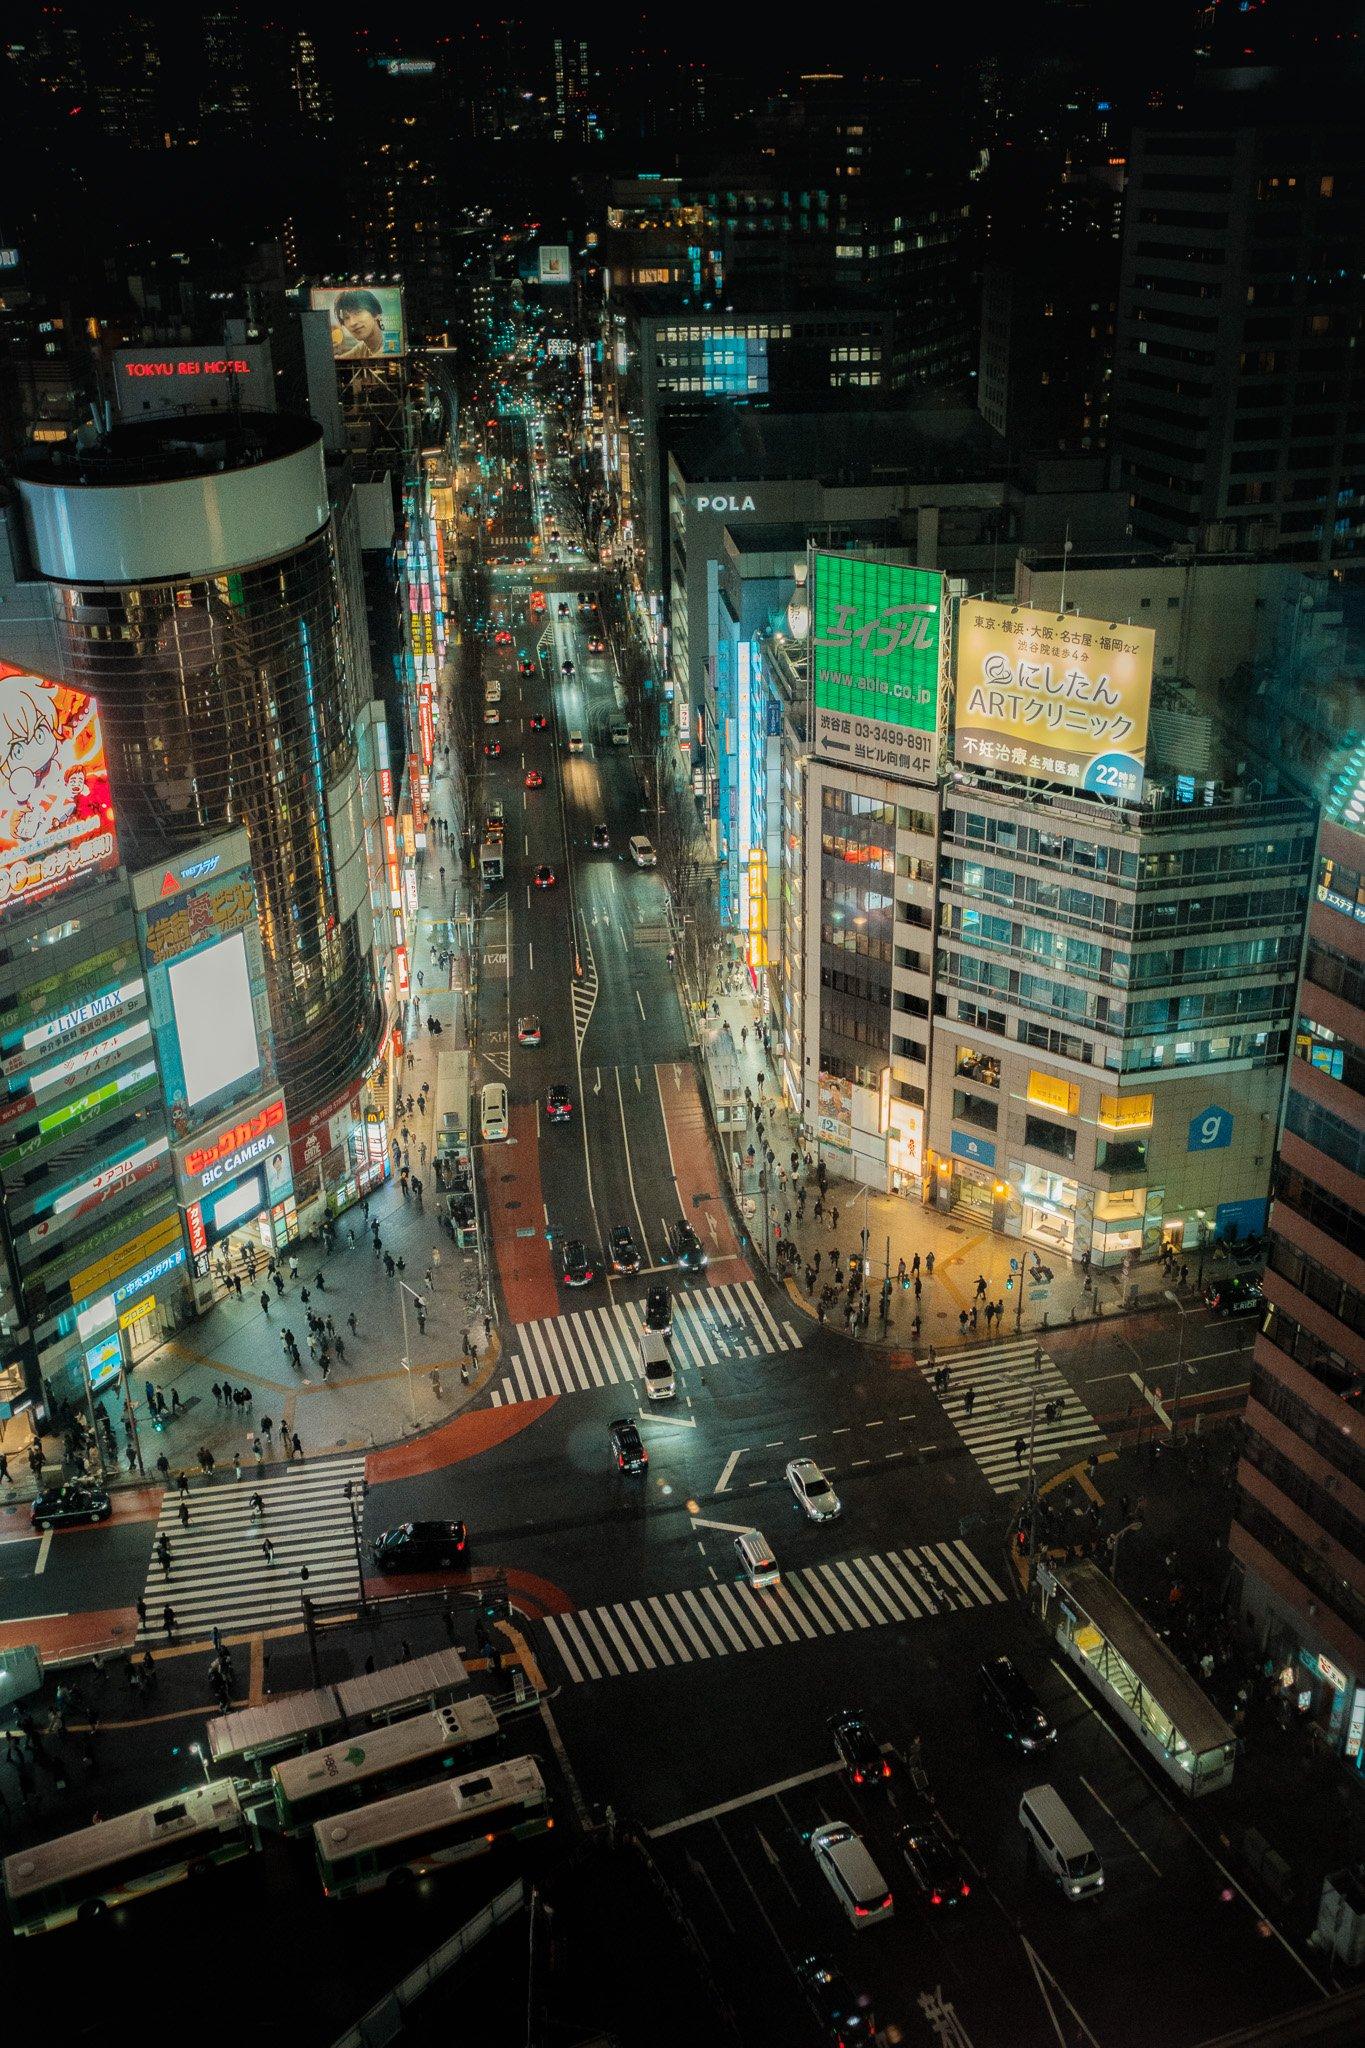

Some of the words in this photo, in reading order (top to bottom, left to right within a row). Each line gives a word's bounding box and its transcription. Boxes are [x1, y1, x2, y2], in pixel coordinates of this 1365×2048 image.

[126, 363, 173, 376] TOKYU
[178, 362, 199, 374] REI
[697, 496, 756, 512] POLA
[813, 604, 937, 657] エイブル
[974, 615, 1140, 655] 東京・横浜・大阪・名古屋・福岡など
[1018, 640, 1090, 662] 渋谷院徒歩4分
[820, 669, 931, 705] www.able.co.jp
[1019, 663, 1118, 706] にしたん
[969, 688, 1132, 740] ARTクリニック
[820, 715, 851, 734] 渋谷店
[855, 722, 931, 752] 03-3499-8911
[963, 737, 1028, 766] 不妊治療
[1029, 755, 1081, 778] 生殖医療
[91, 990, 122, 1016] MAX
[127, 999, 139, 1010] 9F
[184, 1099, 285, 1176] ビックカメラ
[1201, 1116, 1221, 1144] g
[105, 1161, 133, 1182] アコム
[202, 1166, 223, 1187] BIC
[225, 1134, 275, 1171] CAMERA
[126, 1257, 174, 1293] 中央コンタクト
[124, 1303, 151, 1323] プロミス
